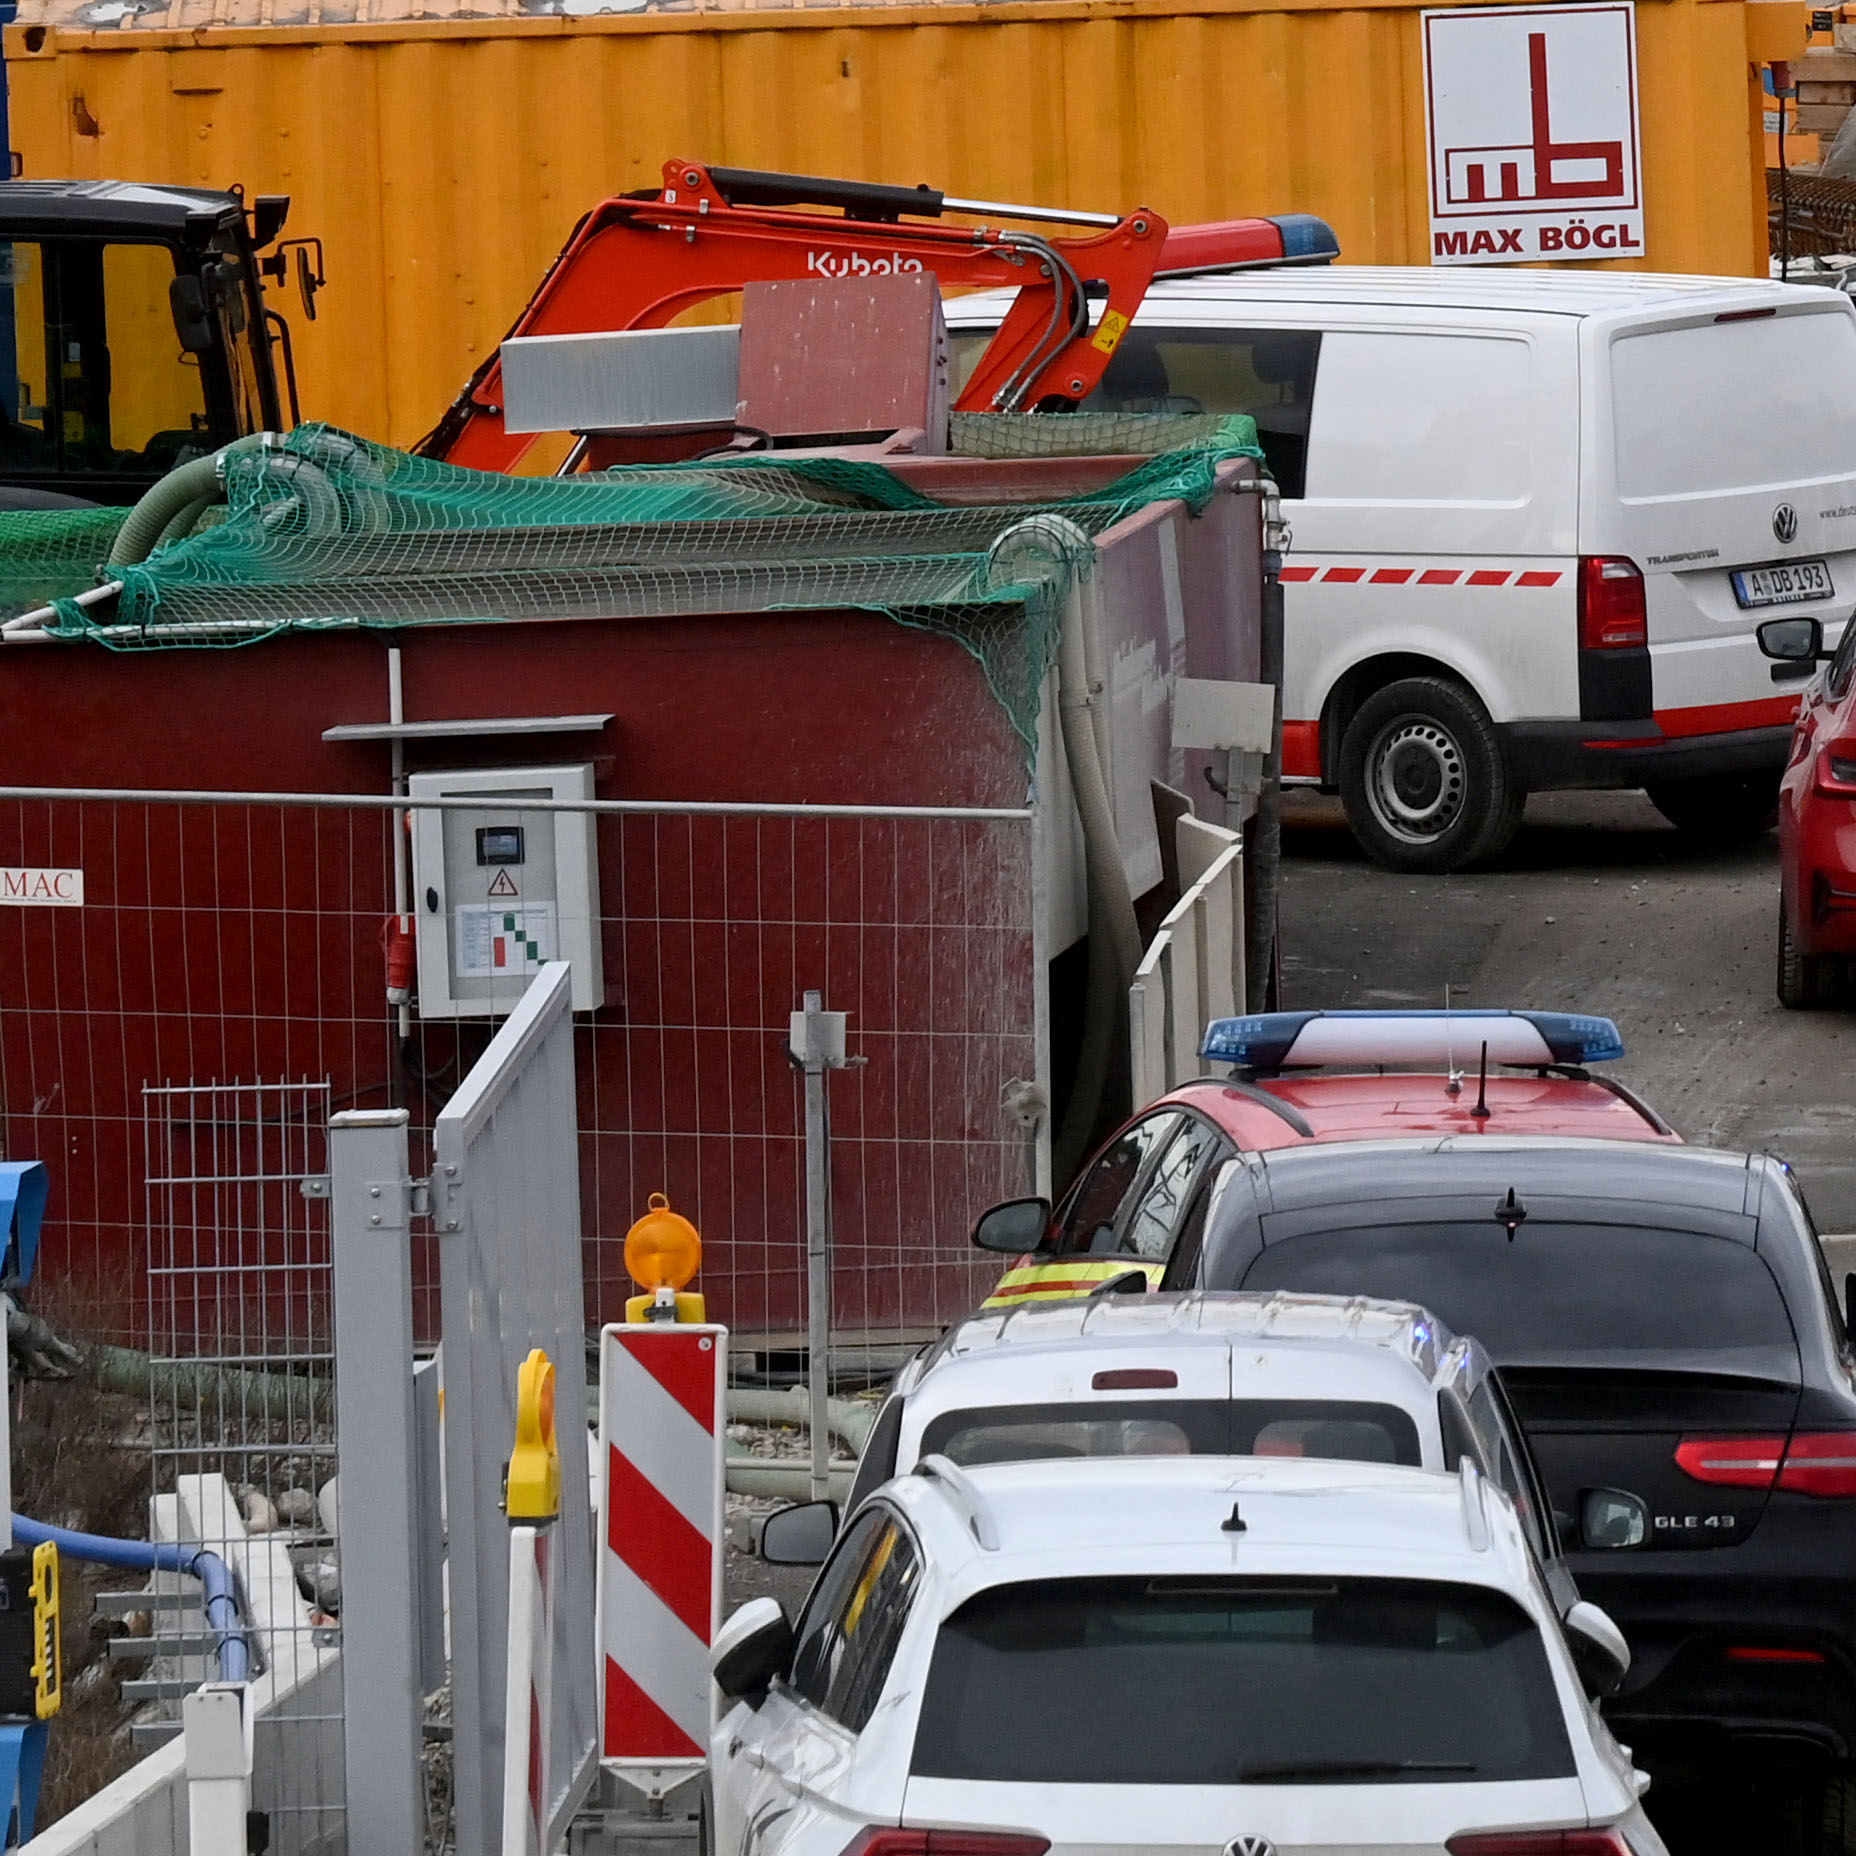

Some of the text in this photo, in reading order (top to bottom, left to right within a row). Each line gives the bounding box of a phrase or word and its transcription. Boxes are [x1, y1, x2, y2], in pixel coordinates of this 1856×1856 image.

[1434, 220, 1642, 257] MAX BÖGL
[807, 250, 924, 278] Kubota
[1751, 566, 1825, 596] A DB 193
[3, 870, 74, 899] MAC
[1654, 1515, 1735, 1528] GLE 43
